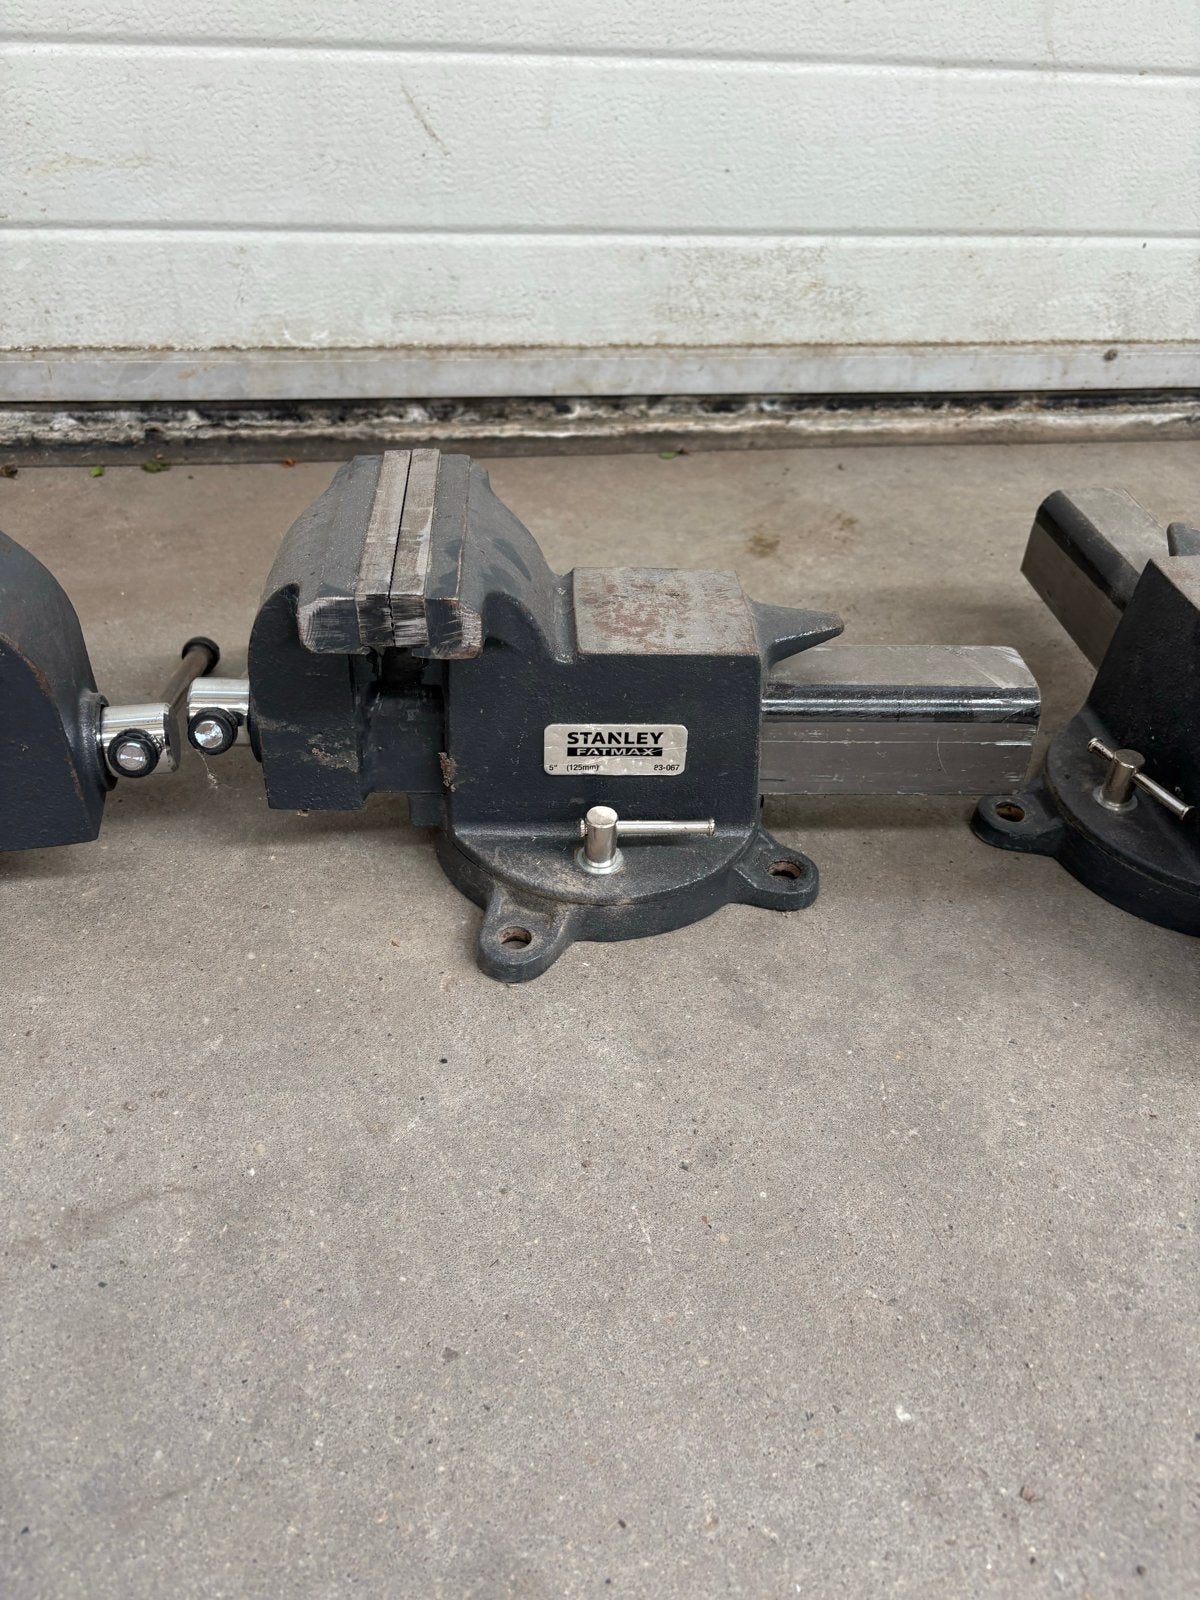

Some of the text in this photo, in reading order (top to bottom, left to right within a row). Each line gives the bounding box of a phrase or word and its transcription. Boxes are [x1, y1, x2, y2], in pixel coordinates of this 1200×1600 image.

[567, 732, 664, 744] STANLEY
[576, 748, 655, 756] FATMAX
[566, 764, 600, 772] (125mm)
